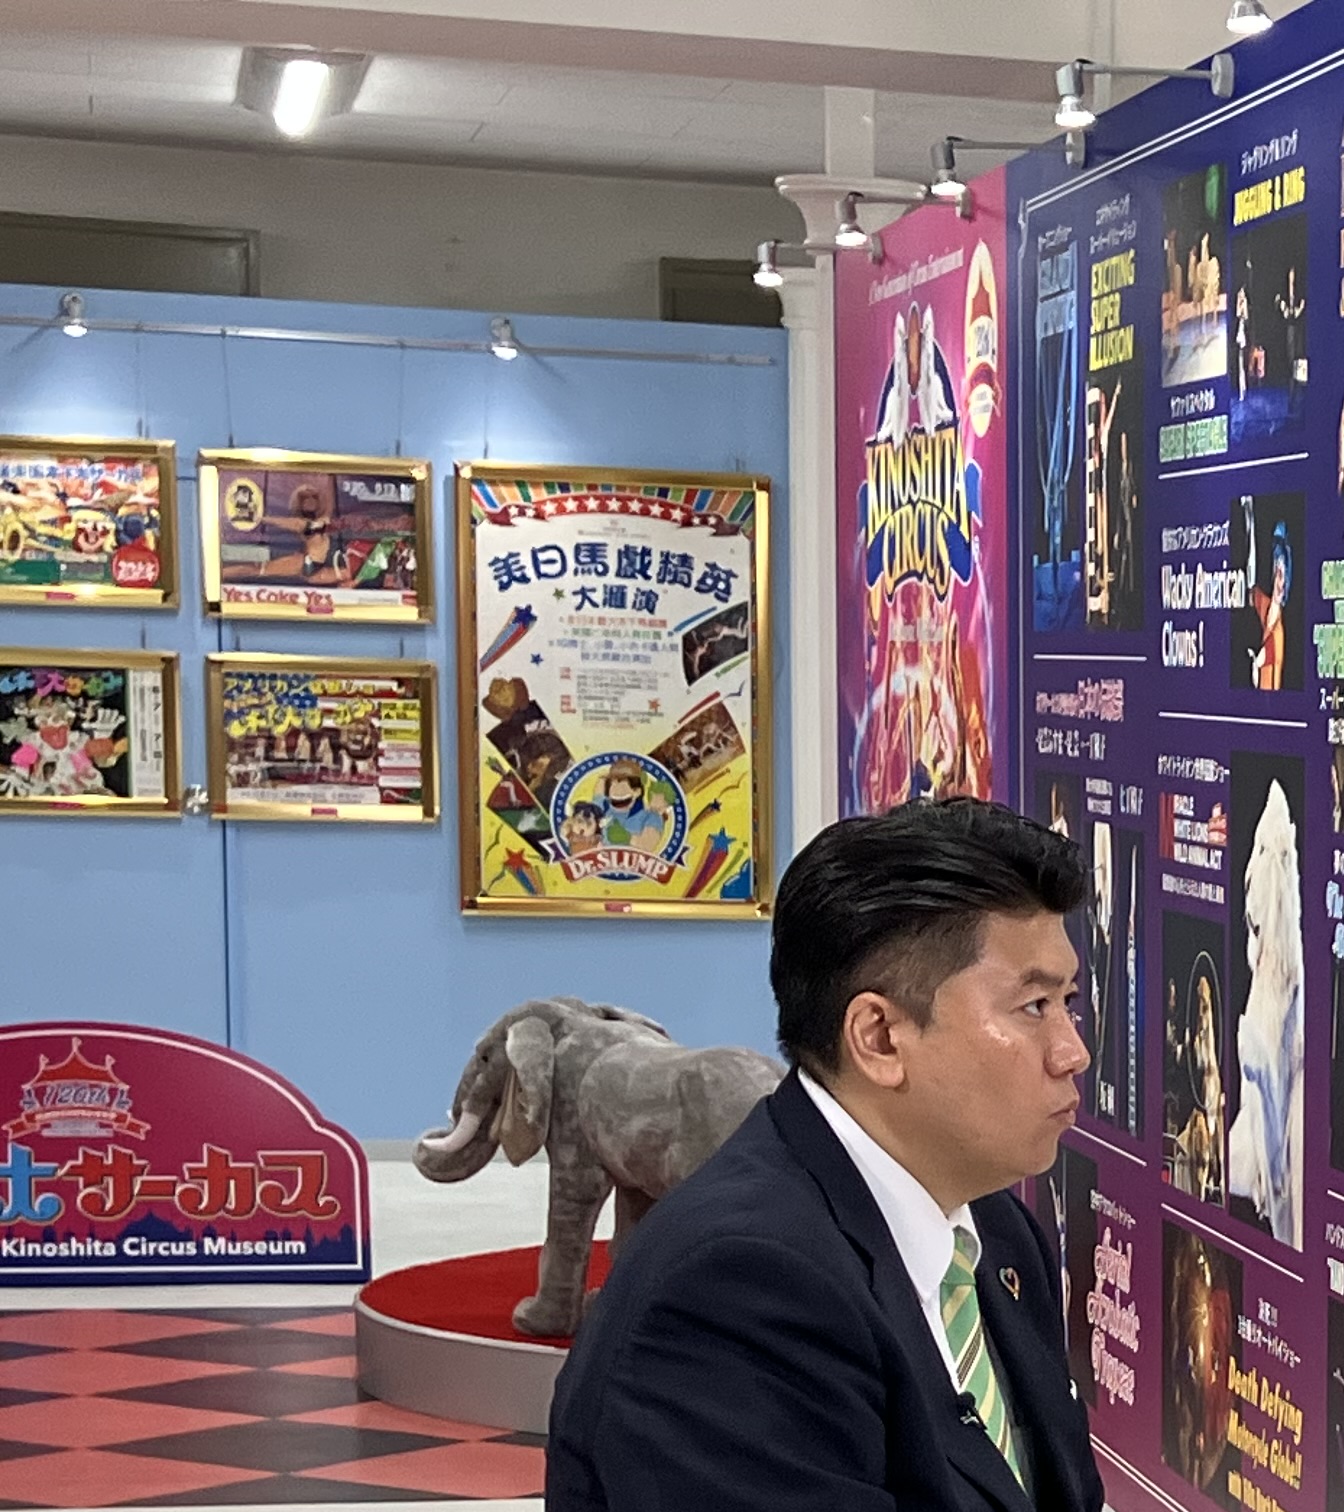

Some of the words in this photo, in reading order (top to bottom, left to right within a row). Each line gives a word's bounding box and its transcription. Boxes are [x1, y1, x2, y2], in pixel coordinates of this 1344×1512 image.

[866, 426, 970, 549] KINOSHITA
[882, 499, 950, 600] CIRCUS
[1160, 562, 1193, 610] Wacky
[1195, 560, 1246, 610] American
[223, 588, 253, 602] Yes
[304, 591, 333, 606] Yes
[1, 1237, 117, 1258] Kinoshita
[122, 1236, 198, 1257] Circus
[203, 1237, 307, 1257] Museum
[1227, 1354, 1259, 1408] Death
[1260, 1375, 1303, 1446] Defying
